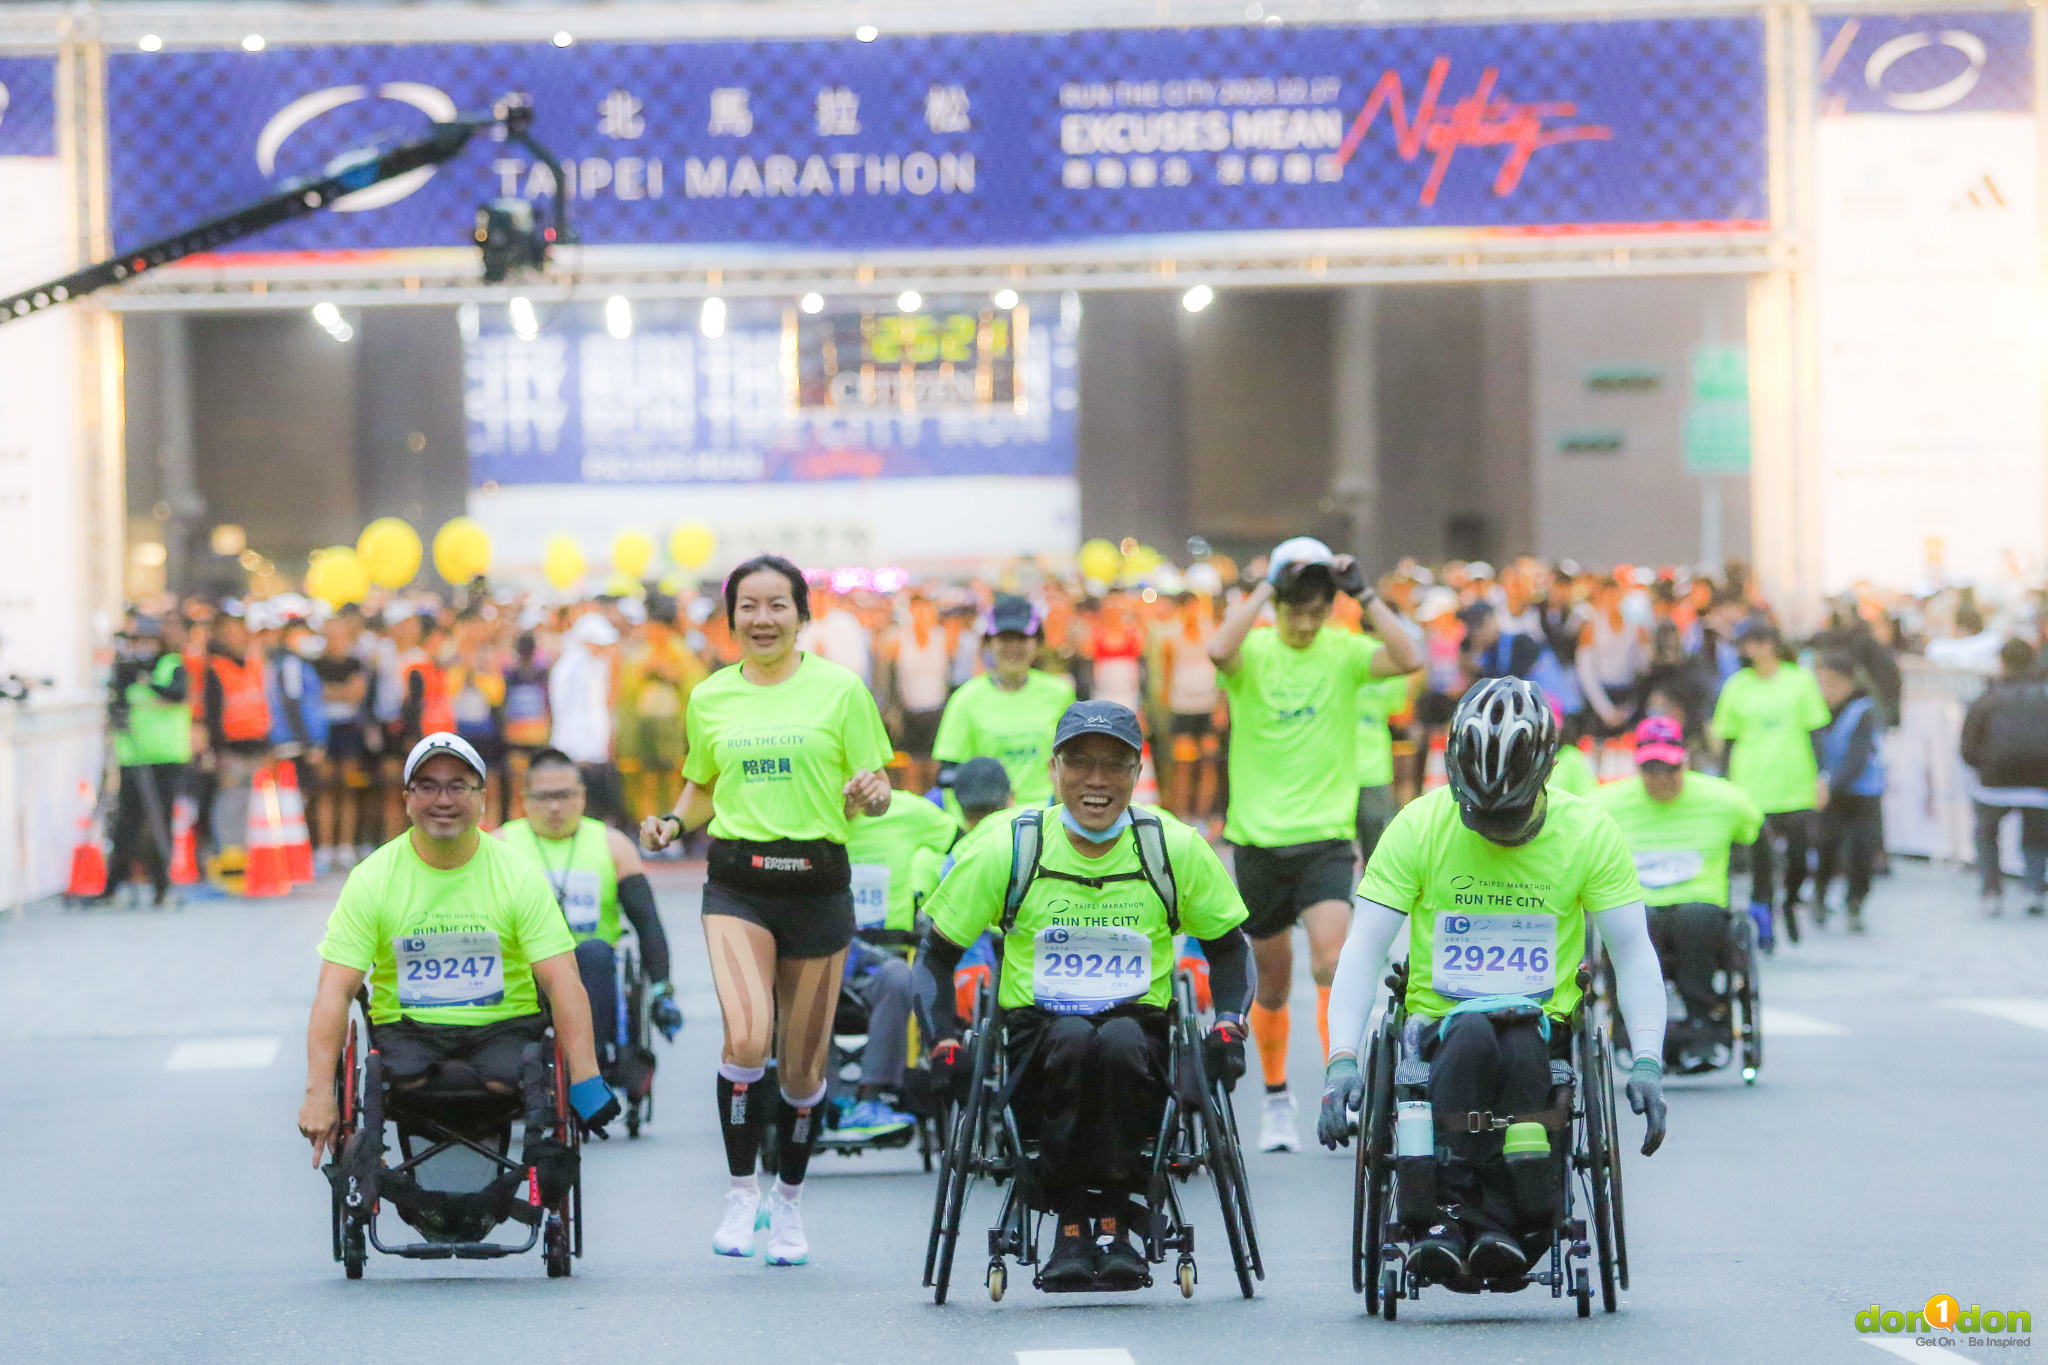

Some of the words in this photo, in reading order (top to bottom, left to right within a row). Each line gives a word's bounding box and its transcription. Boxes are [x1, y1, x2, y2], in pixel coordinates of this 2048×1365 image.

[1061, 110, 1231, 154] EXCUSES
[1233, 108, 1343, 149] MEAN
[494, 157, 663, 200] TAIPEI
[685, 151, 976, 199] MARATHON
[728, 738, 751, 749] RUN
[755, 736, 776, 746] THE
[780, 735, 805, 745] CITY
[742, 758, 791, 775] 陪跑員
[1479, 880, 1504, 888] TAIPEI
[1507, 882, 1551, 891] MARATHON
[1102, 901, 1144, 910] MARATHON
[1455, 894, 1483, 905] RUN
[1487, 895, 1512, 906] THE
[1517, 896, 1545, 908] CITY
[1052, 917, 1079, 927] RUN
[1083, 917, 1108, 927] THE
[1112, 915, 1139, 926] CITY
[1455, 918, 1468, 931] C
[413, 926, 437, 936] RUN
[1054, 929, 1068, 941] C
[1044, 953, 1144, 978] 29244
[1443, 945, 1549, 973] 29246
[407, 956, 495, 980] 29247
